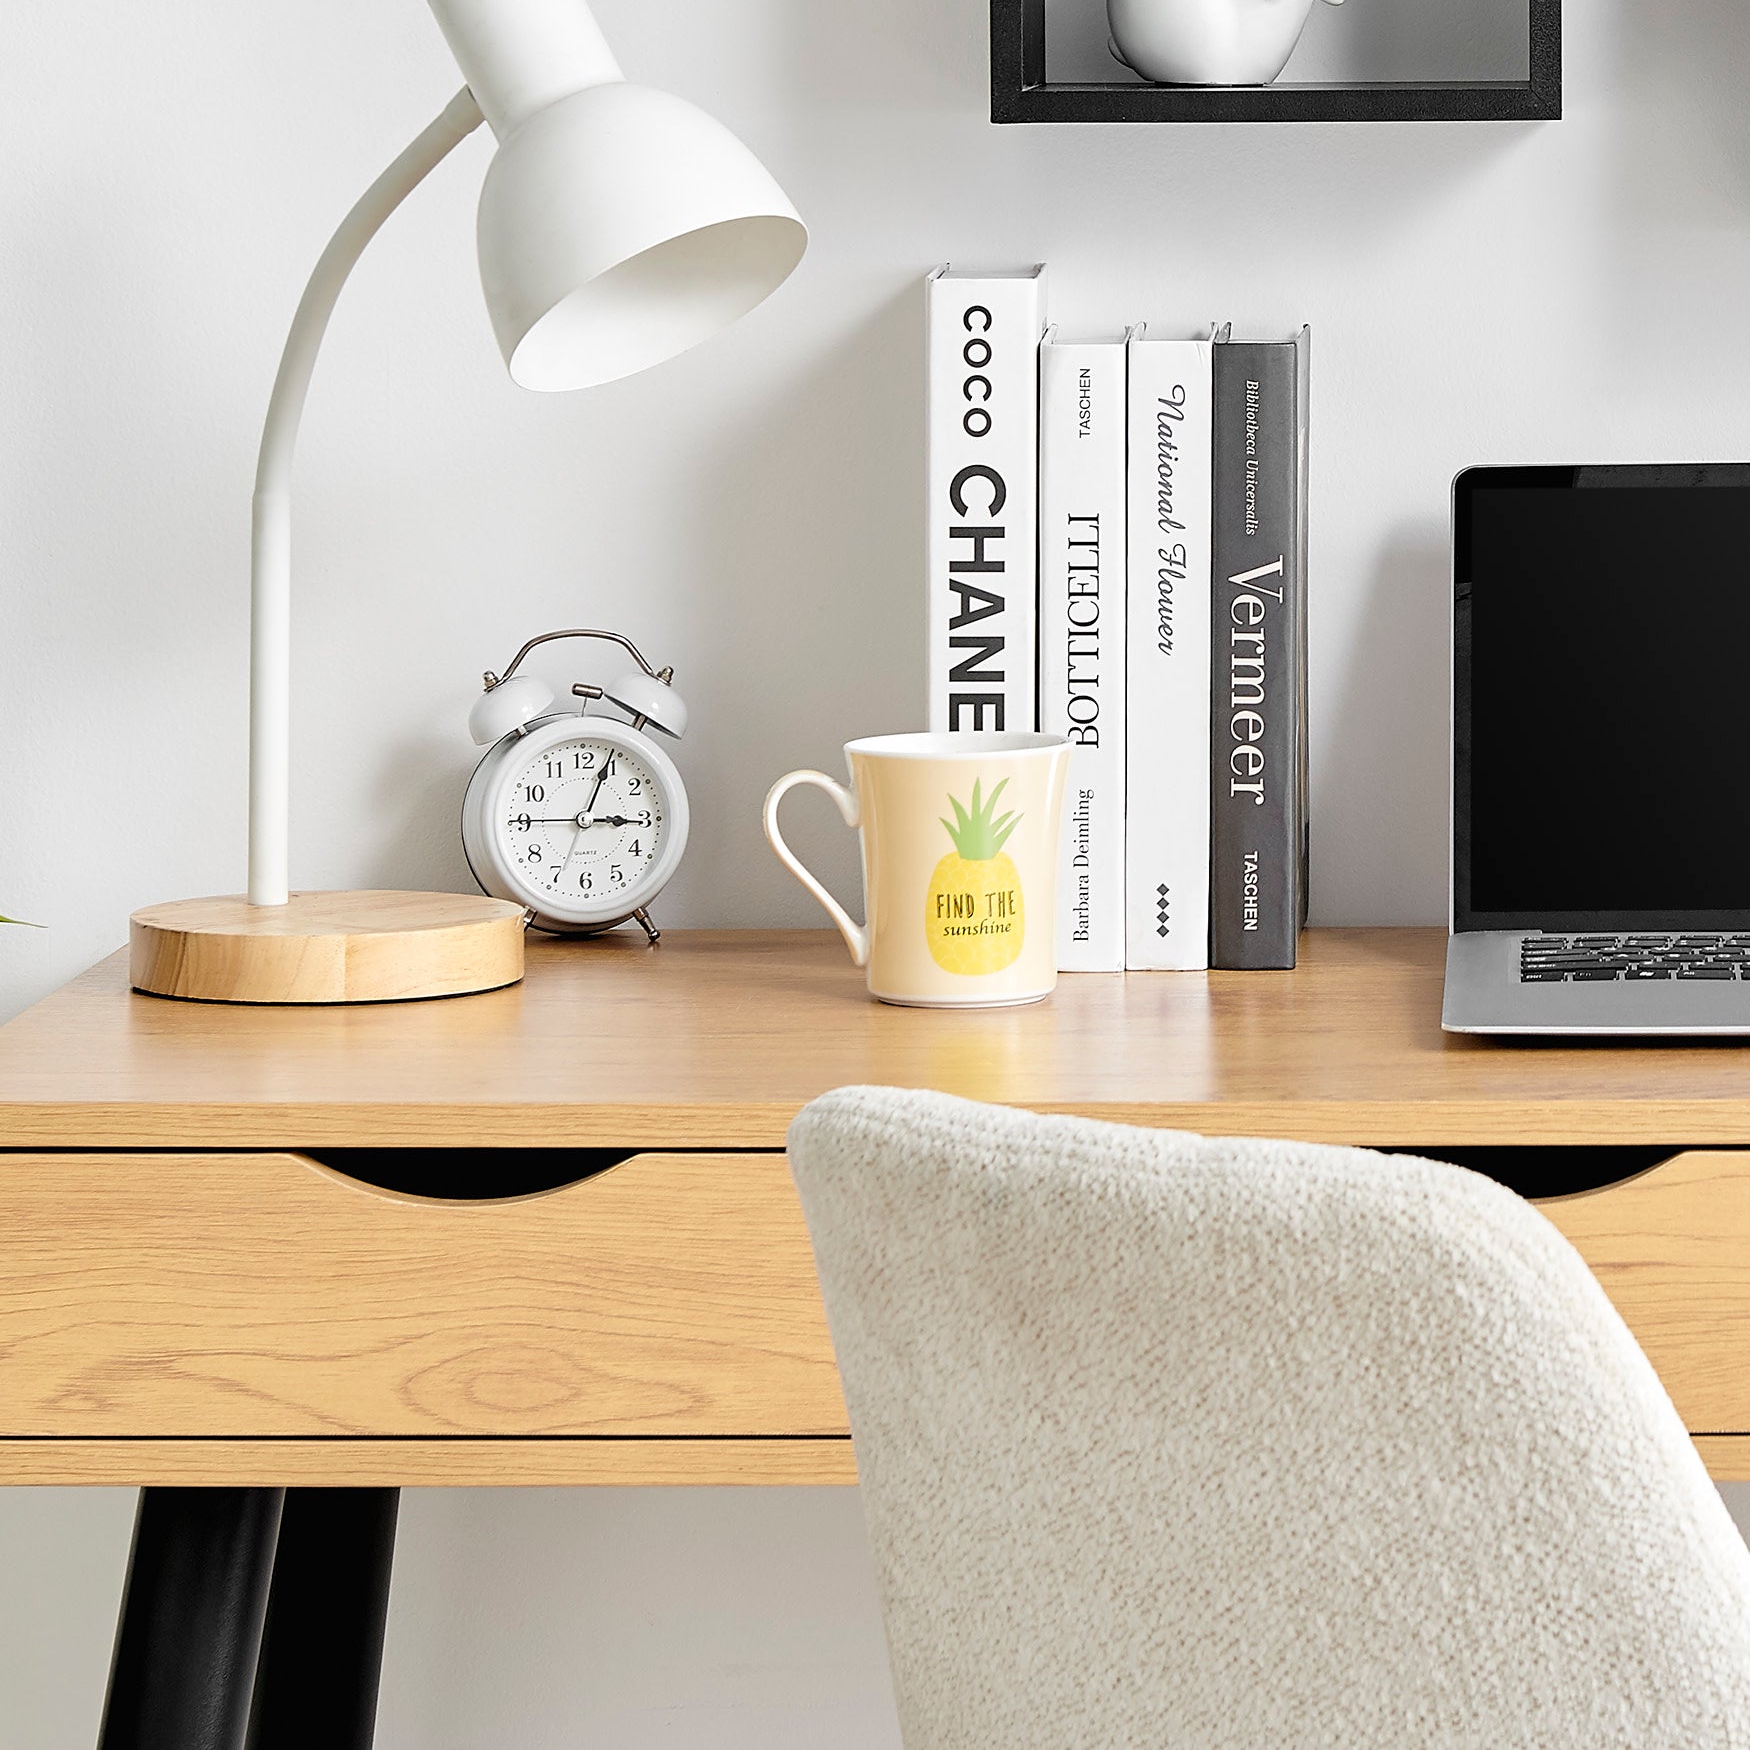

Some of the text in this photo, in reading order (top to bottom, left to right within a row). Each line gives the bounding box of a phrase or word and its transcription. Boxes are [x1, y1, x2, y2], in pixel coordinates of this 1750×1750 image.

[1078, 368, 1091, 439] TASCHEN
[949, 305, 1007, 732] COCO CHANE
[1157, 384, 1187, 657] National Flower
[1067, 513, 1100, 749] BOTTICELLI
[1228, 554, 1284, 806] Vermeer
[546, 761, 562, 779] 11
[574, 752, 595, 770] 12
[610, 759, 616, 776] 1
[525, 785, 545, 803] 10
[628, 777, 642, 796] 2
[517, 812, 531, 832] 9
[638, 810, 652, 828] 3
[527, 843, 542, 863] 8
[628, 839, 643, 857] 4
[550, 866, 562, 883] 7
[610, 863, 624, 882] 5
[1072, 788, 1095, 942] Barbara Deimling
[580, 871, 593, 890] 6
[1243, 850, 1258, 931] TASCHEN
[936, 890, 1016, 919] FIND THE
[942, 919, 1012, 938] sunshine
